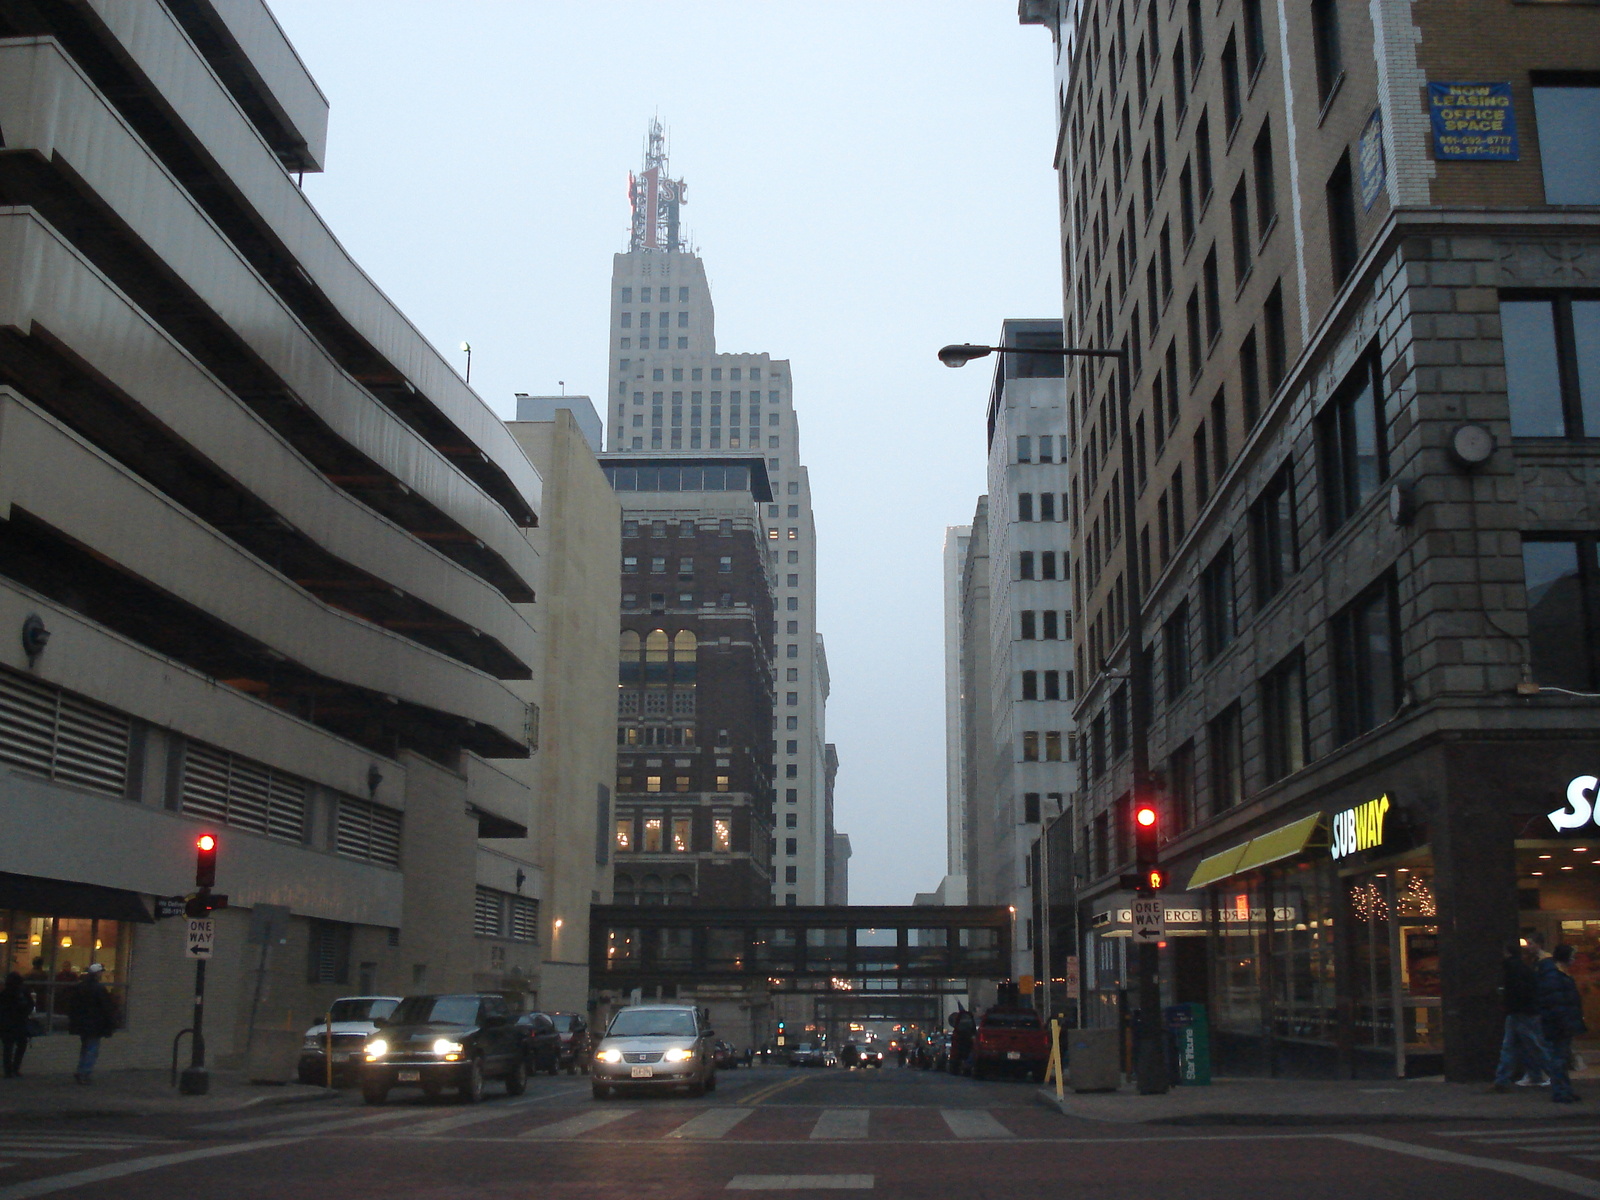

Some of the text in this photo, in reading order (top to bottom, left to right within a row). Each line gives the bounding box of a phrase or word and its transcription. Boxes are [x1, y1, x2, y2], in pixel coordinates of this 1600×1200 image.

[1450, 86, 1490, 95] NOW
[1433, 96, 1510, 107] LEASING
[1440, 109, 1505, 120] OFFICE
[1445, 120, 1503, 131] SPACE
[640, 165, 688, 249] 1st
[1547, 775, 1600, 833] S
[1331, 793, 1389, 861] SUBWAY
[1135, 902, 1160, 913] ONE
[1121, 910, 1199, 921] CERCE
[1136, 914, 1161, 926] WAY
[190, 921, 212, 931] ONE
[190, 933, 212, 942] WAY
